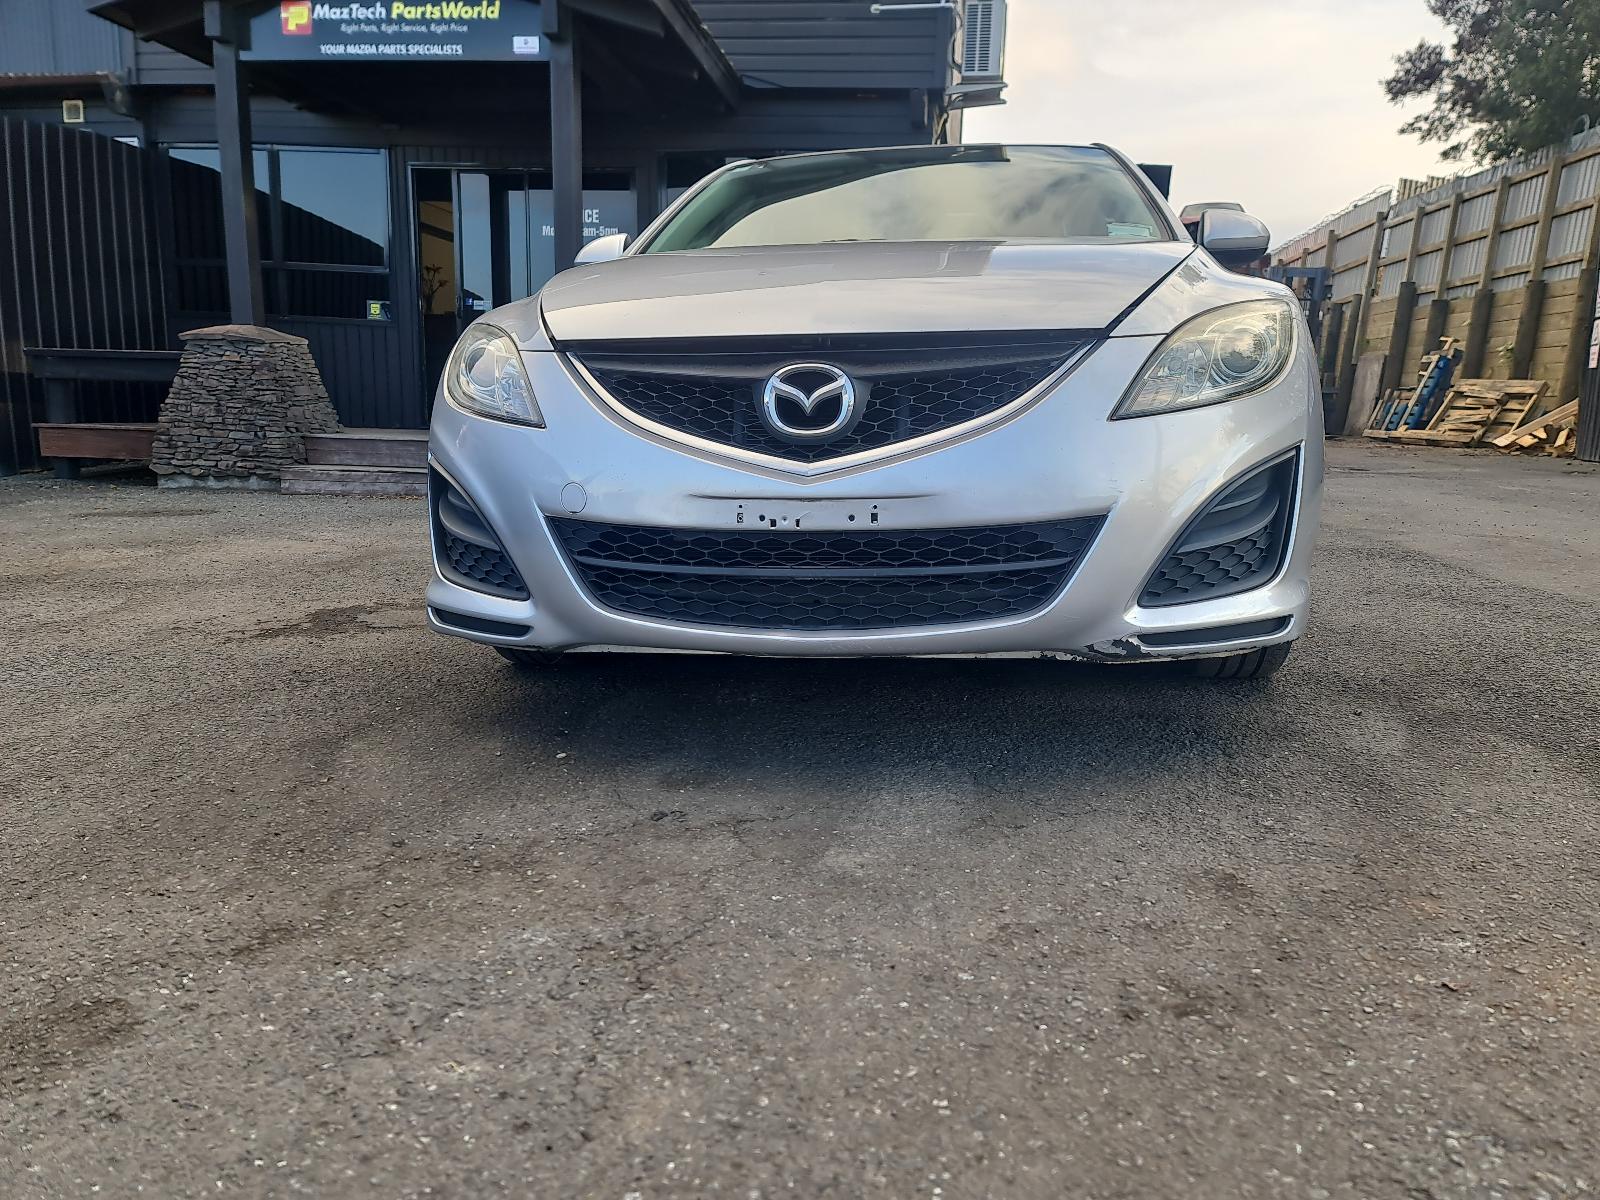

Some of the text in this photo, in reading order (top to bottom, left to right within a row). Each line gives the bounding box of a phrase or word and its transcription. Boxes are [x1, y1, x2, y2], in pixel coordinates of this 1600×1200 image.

[312, 0, 500, 19] MazTech PartsWorld
[340, 23, 359, 34] Right
[381, 23, 400, 34] Right
[430, 22, 449, 34] Right
[450, 22, 468, 32] Price
[320, 43, 463, 55] YOUR MAZDA PARTS SPECIALISTS
